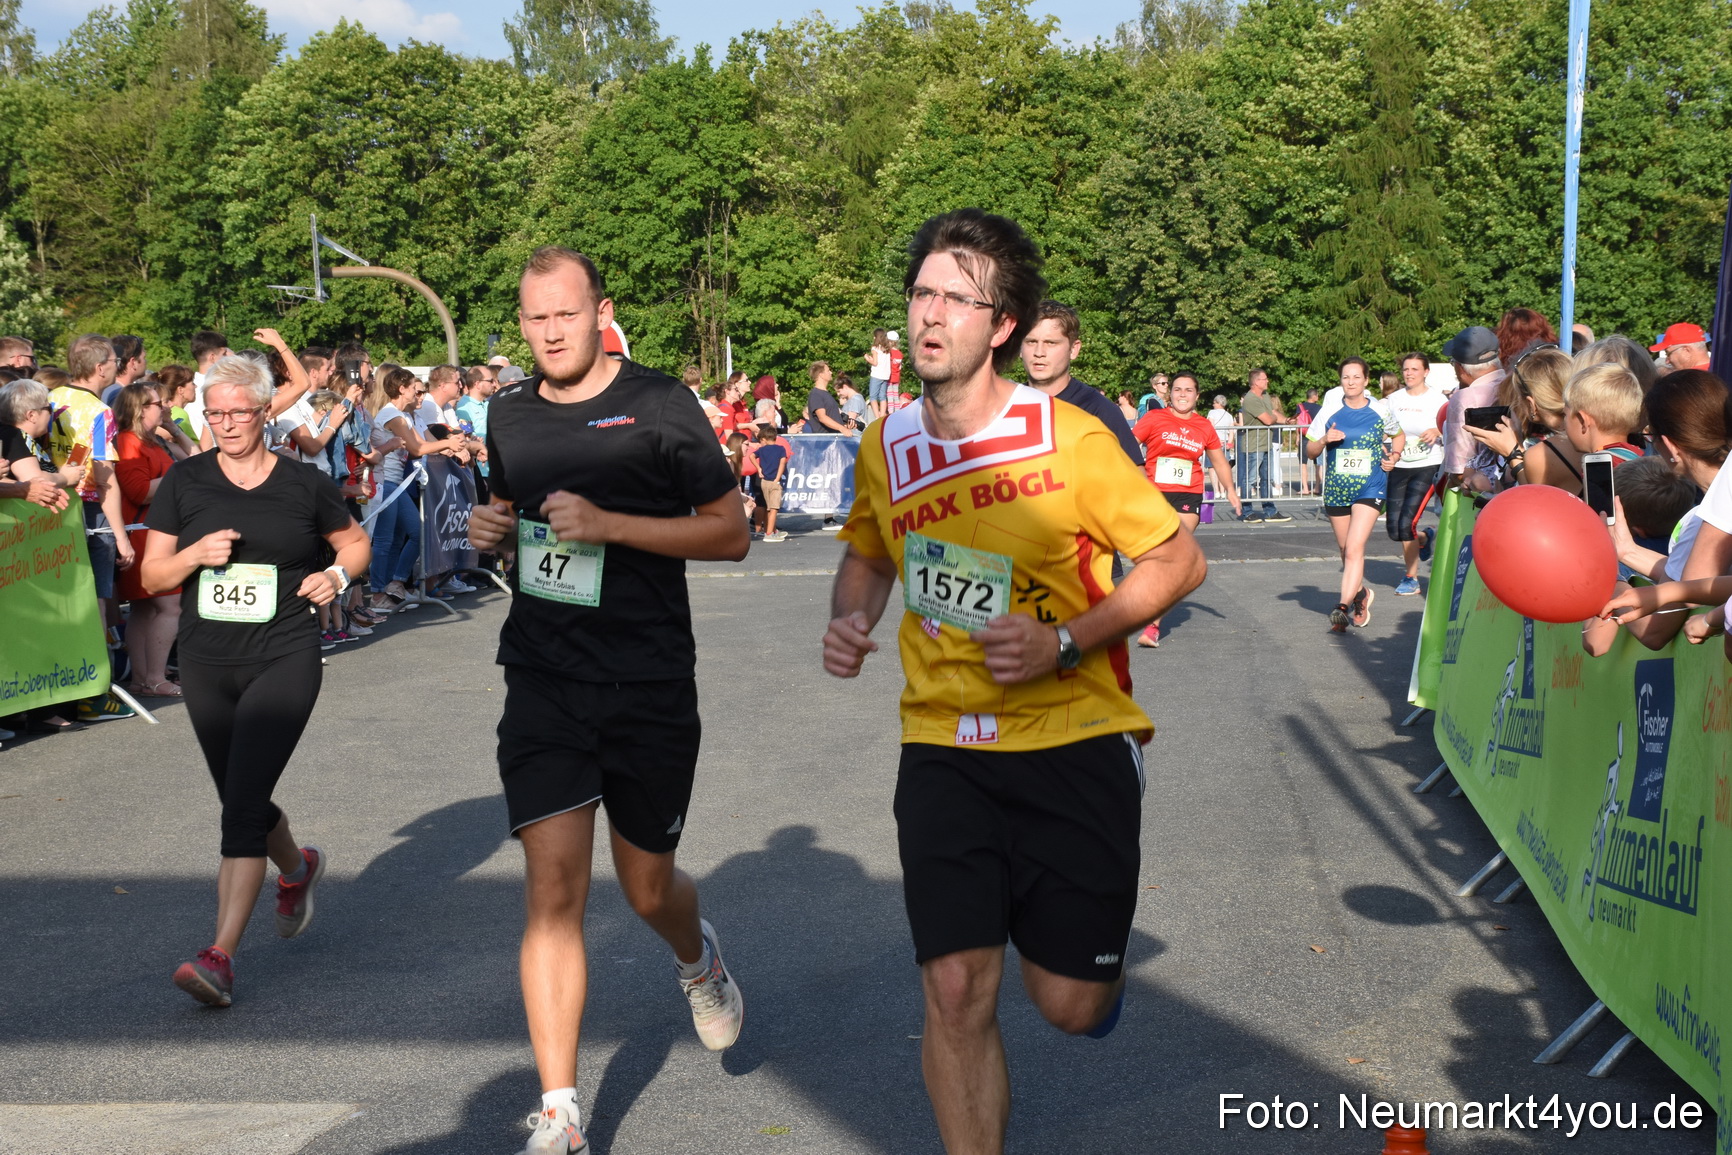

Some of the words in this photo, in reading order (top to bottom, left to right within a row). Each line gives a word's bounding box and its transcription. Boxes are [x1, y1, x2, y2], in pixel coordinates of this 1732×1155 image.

[1343, 458, 1363, 468] 267
[891, 492, 962, 541] MAX
[969, 469, 1066, 510] BÖGL
[33, 532, 80, 579] länger!
[538, 551, 571, 580] 47
[213, 583, 257, 606] 845
[553, 581, 576, 591] Tobias
[916, 566, 994, 614] 1572
[1643, 709, 1669, 737] Fischer
[1603, 800, 1705, 916] firmenlauf
[1598, 897, 1637, 933] neumarkt
